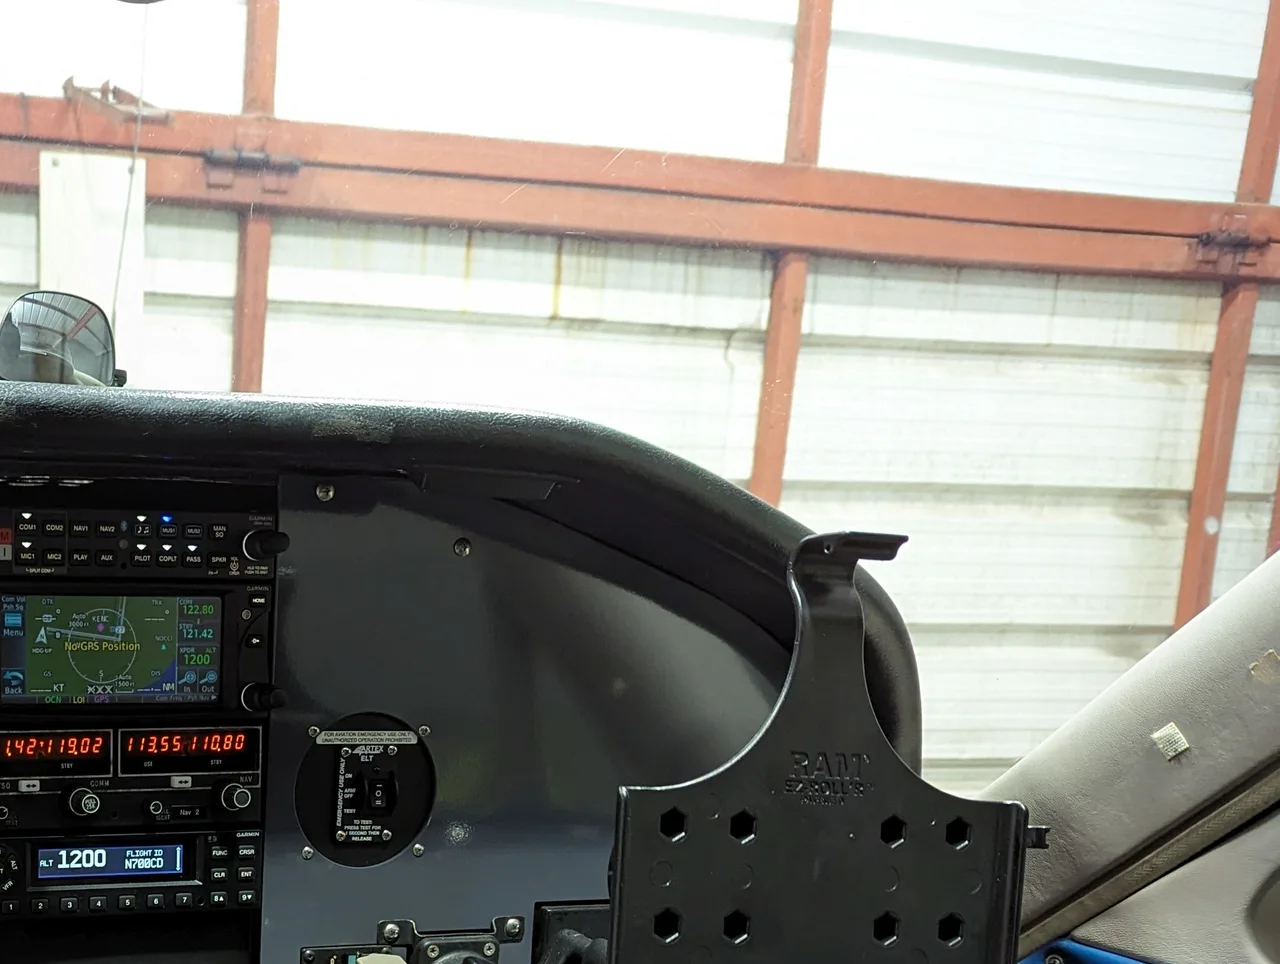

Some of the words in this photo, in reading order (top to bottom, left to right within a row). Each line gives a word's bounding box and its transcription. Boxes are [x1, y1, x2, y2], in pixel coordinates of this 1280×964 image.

[183, 605, 213, 614] 122.80
[183, 629, 213, 638] 121.42
[64, 642, 77, 650] No
[81, 642, 99, 650] GPS
[102, 642, 140, 651] Position
[184, 655, 210, 664] 1200
[48, 738, 102, 755] 119.02
[128, 736, 181, 753] 113.55
[192, 735, 244, 752] 110.80
[789, 751, 862, 780] RAM
[58, 849, 106, 868] 1200
[125, 858, 163, 869] N700CD
